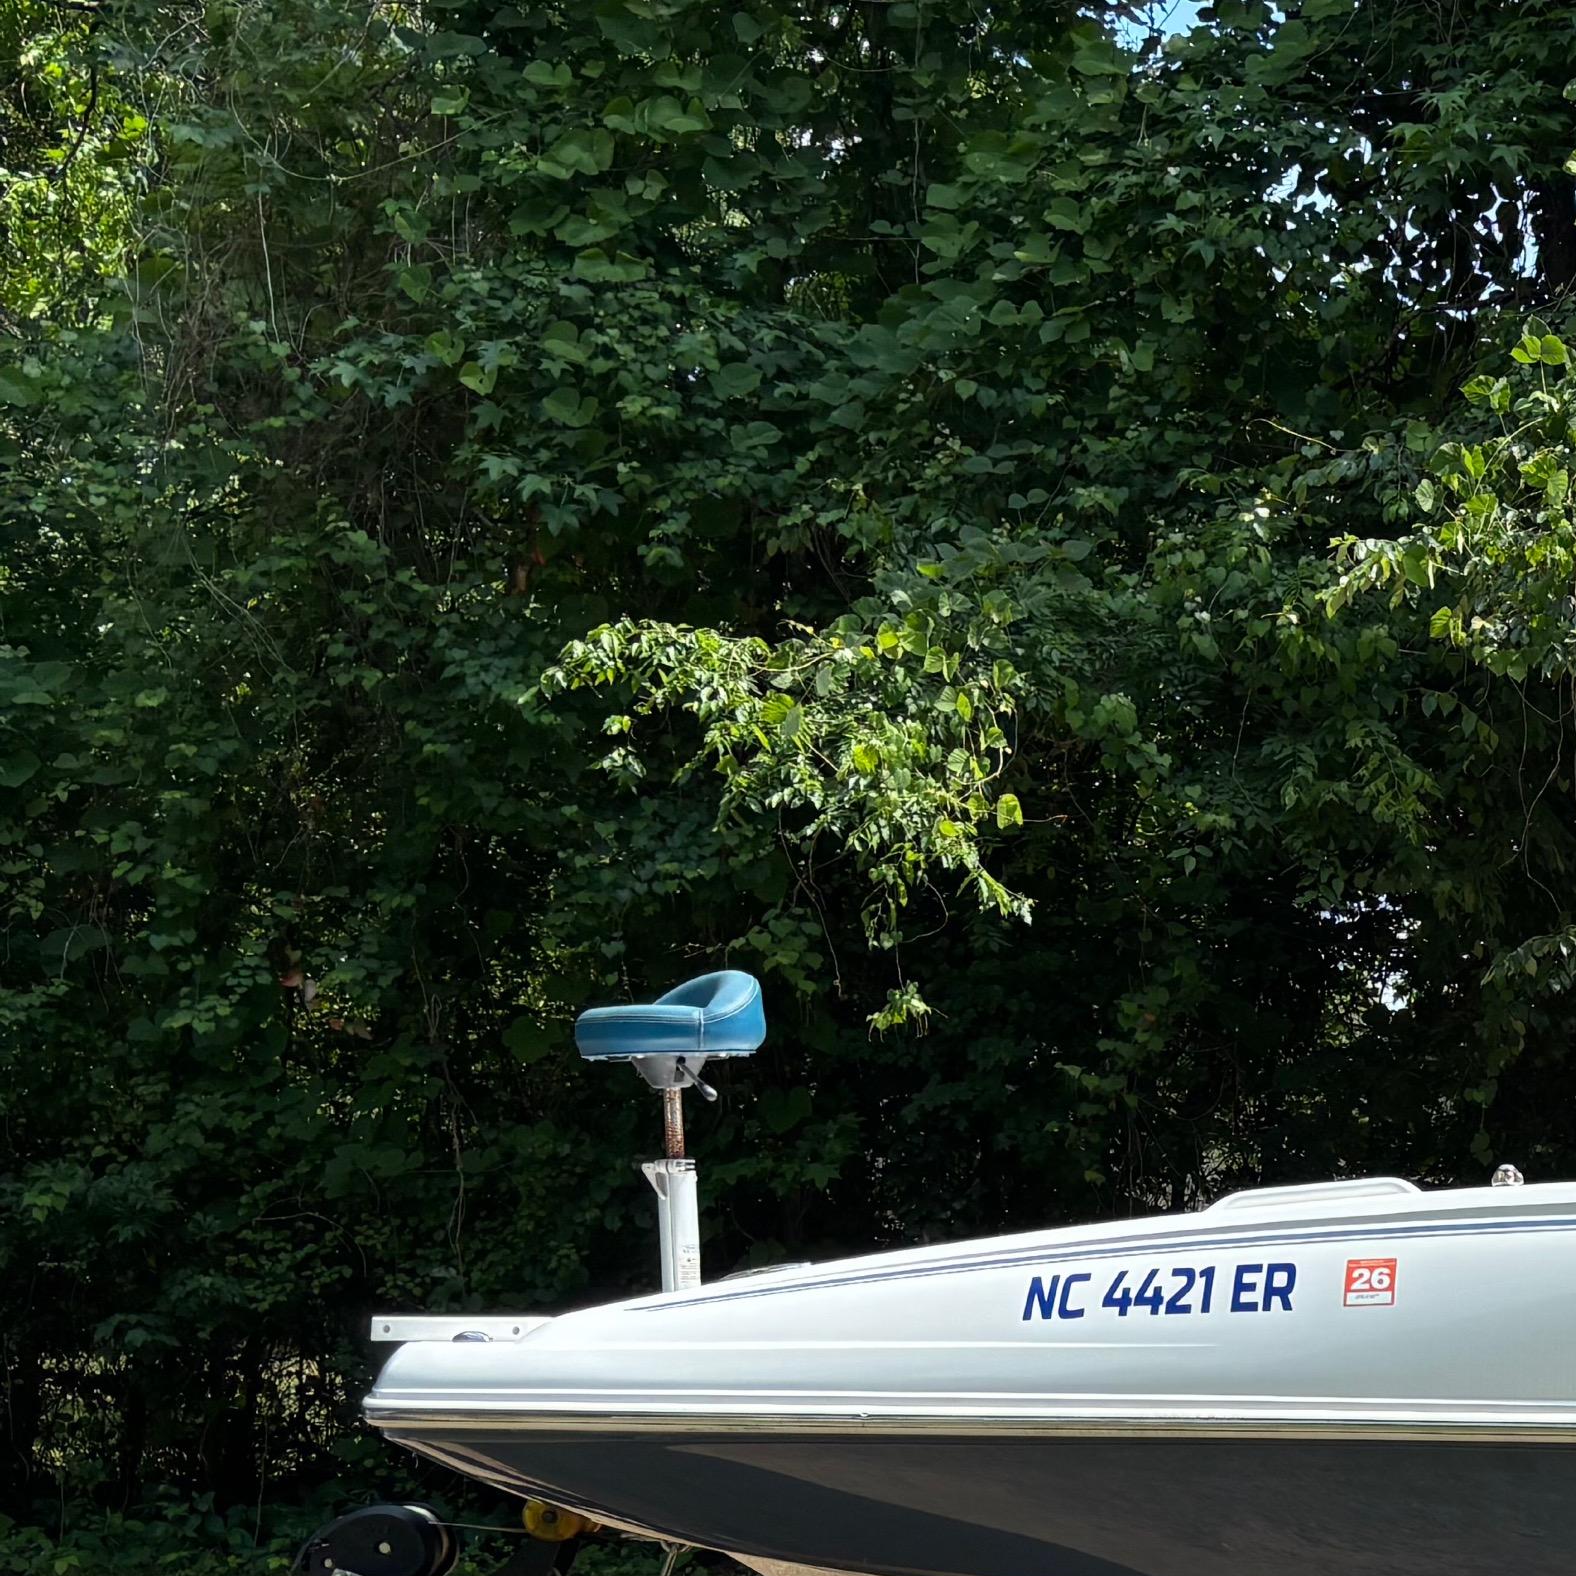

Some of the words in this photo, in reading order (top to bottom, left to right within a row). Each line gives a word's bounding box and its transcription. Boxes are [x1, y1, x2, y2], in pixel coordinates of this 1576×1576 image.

[1022, 1272, 1092, 1321] NC
[1102, 1265, 1216, 1317] 4421
[1230, 1262, 1297, 1313] ER
[1350, 1267, 1391, 1290] 26
